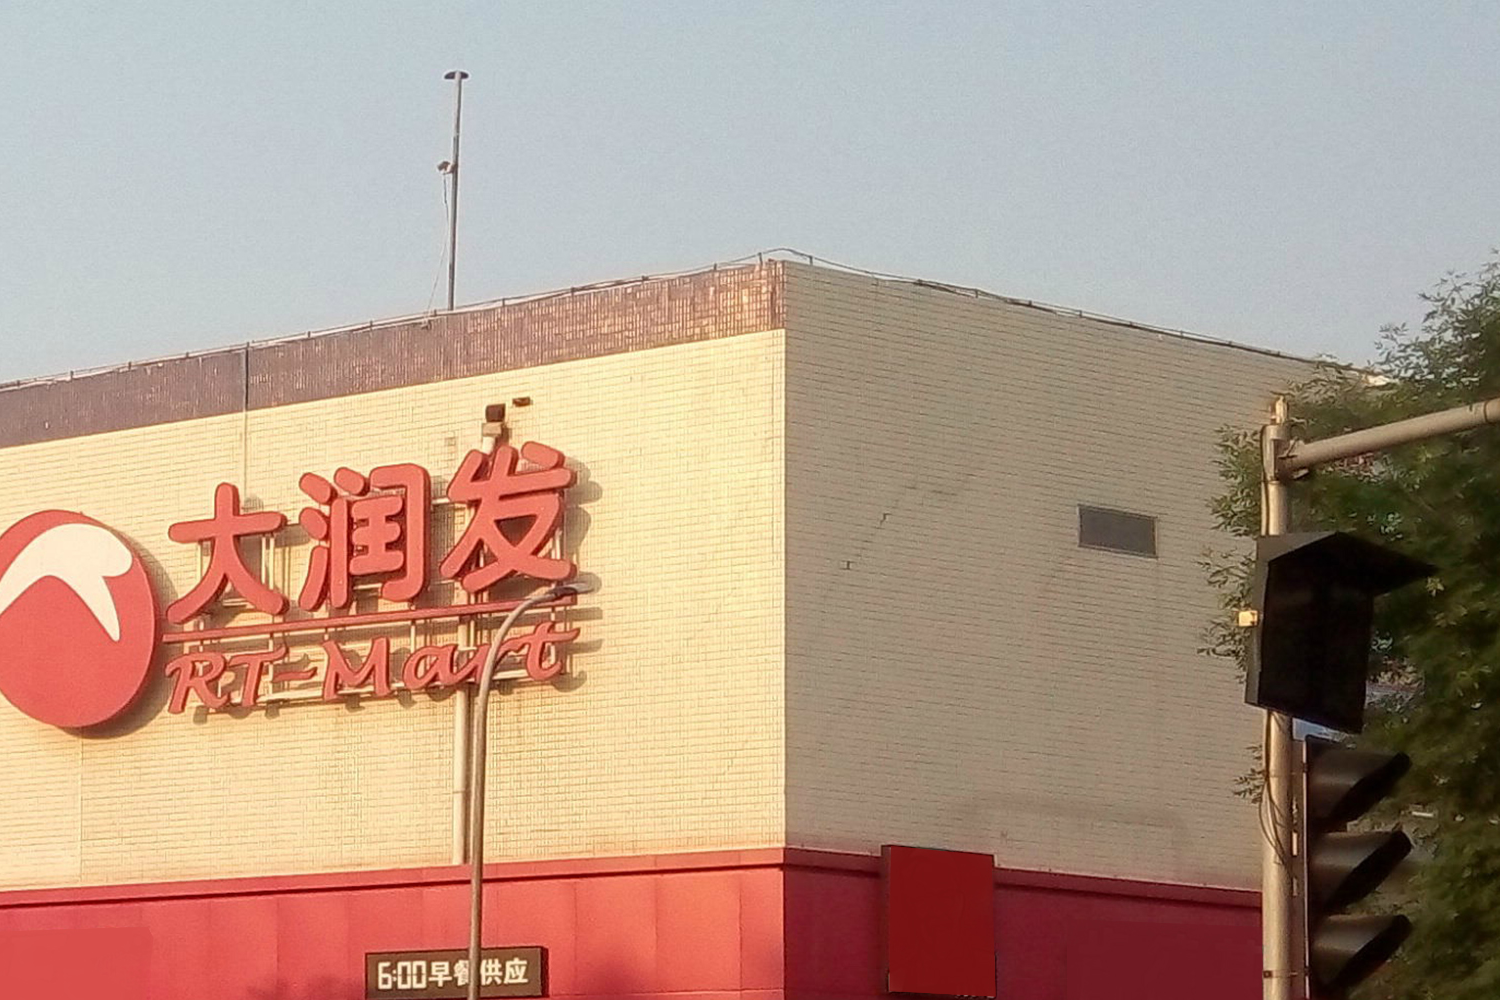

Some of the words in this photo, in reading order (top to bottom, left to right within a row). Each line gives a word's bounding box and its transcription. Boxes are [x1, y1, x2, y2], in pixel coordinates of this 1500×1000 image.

[167, 441, 577, 622] 大润发
[165, 624, 580, 714] RT-Mart
